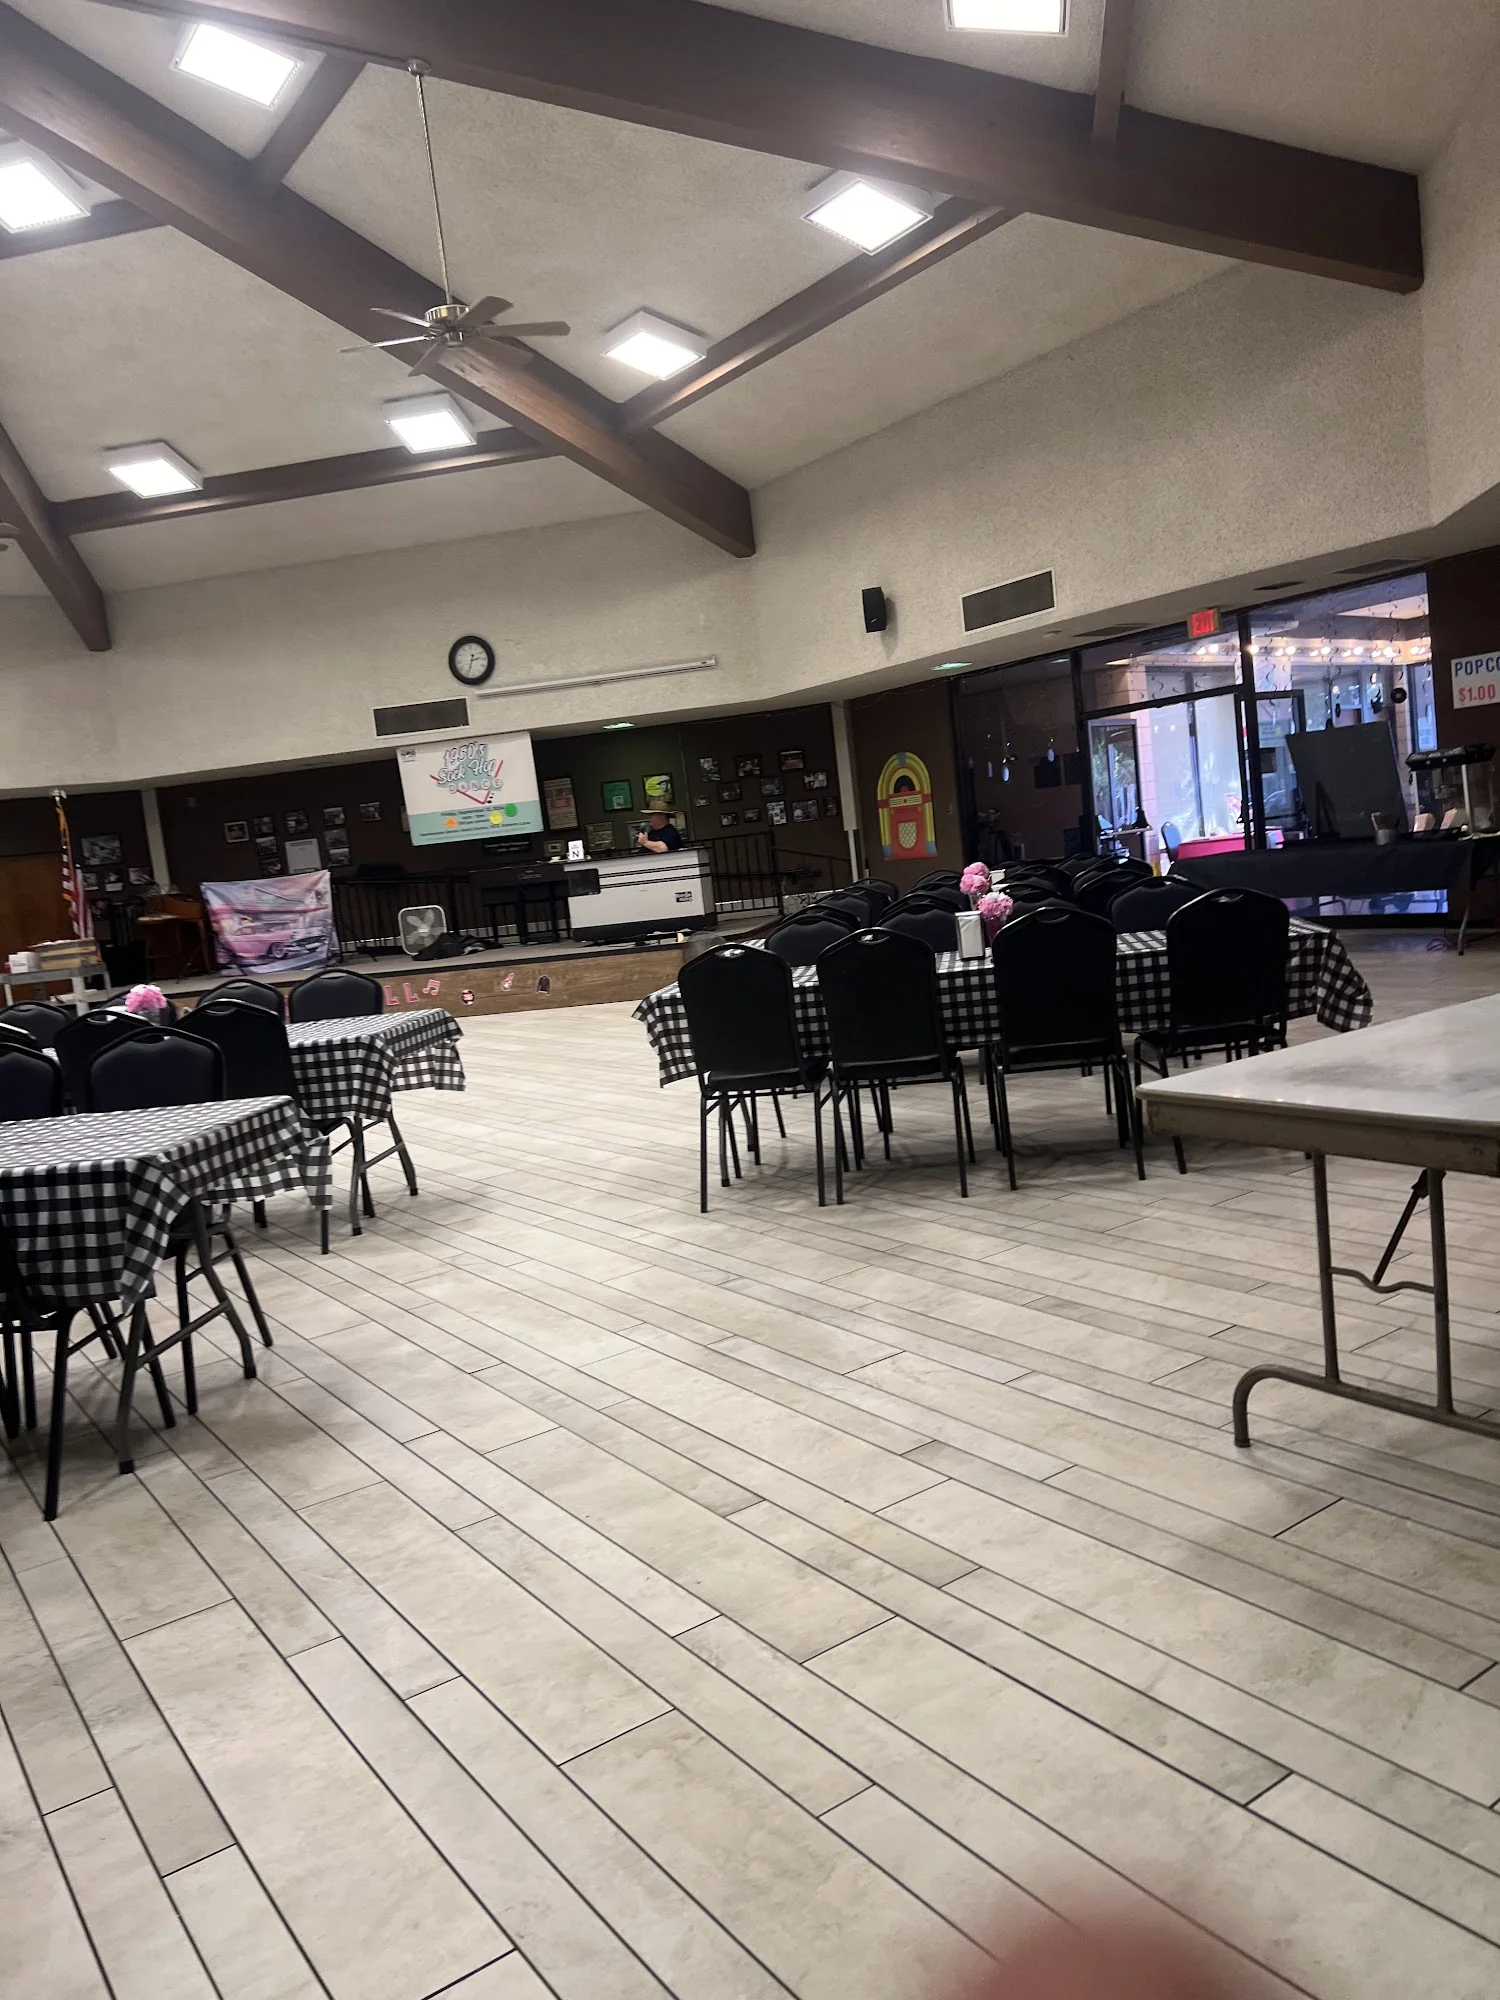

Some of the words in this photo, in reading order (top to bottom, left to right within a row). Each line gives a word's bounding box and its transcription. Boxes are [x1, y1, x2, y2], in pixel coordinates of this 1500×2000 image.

[1192, 610, 1214, 636] EXIT
[1459, 684, 1496, 702] $1.00
[443, 740, 486, 767] 1950's
[438, 764, 466, 785] Sock
[449, 778, 503, 794] DANCE
